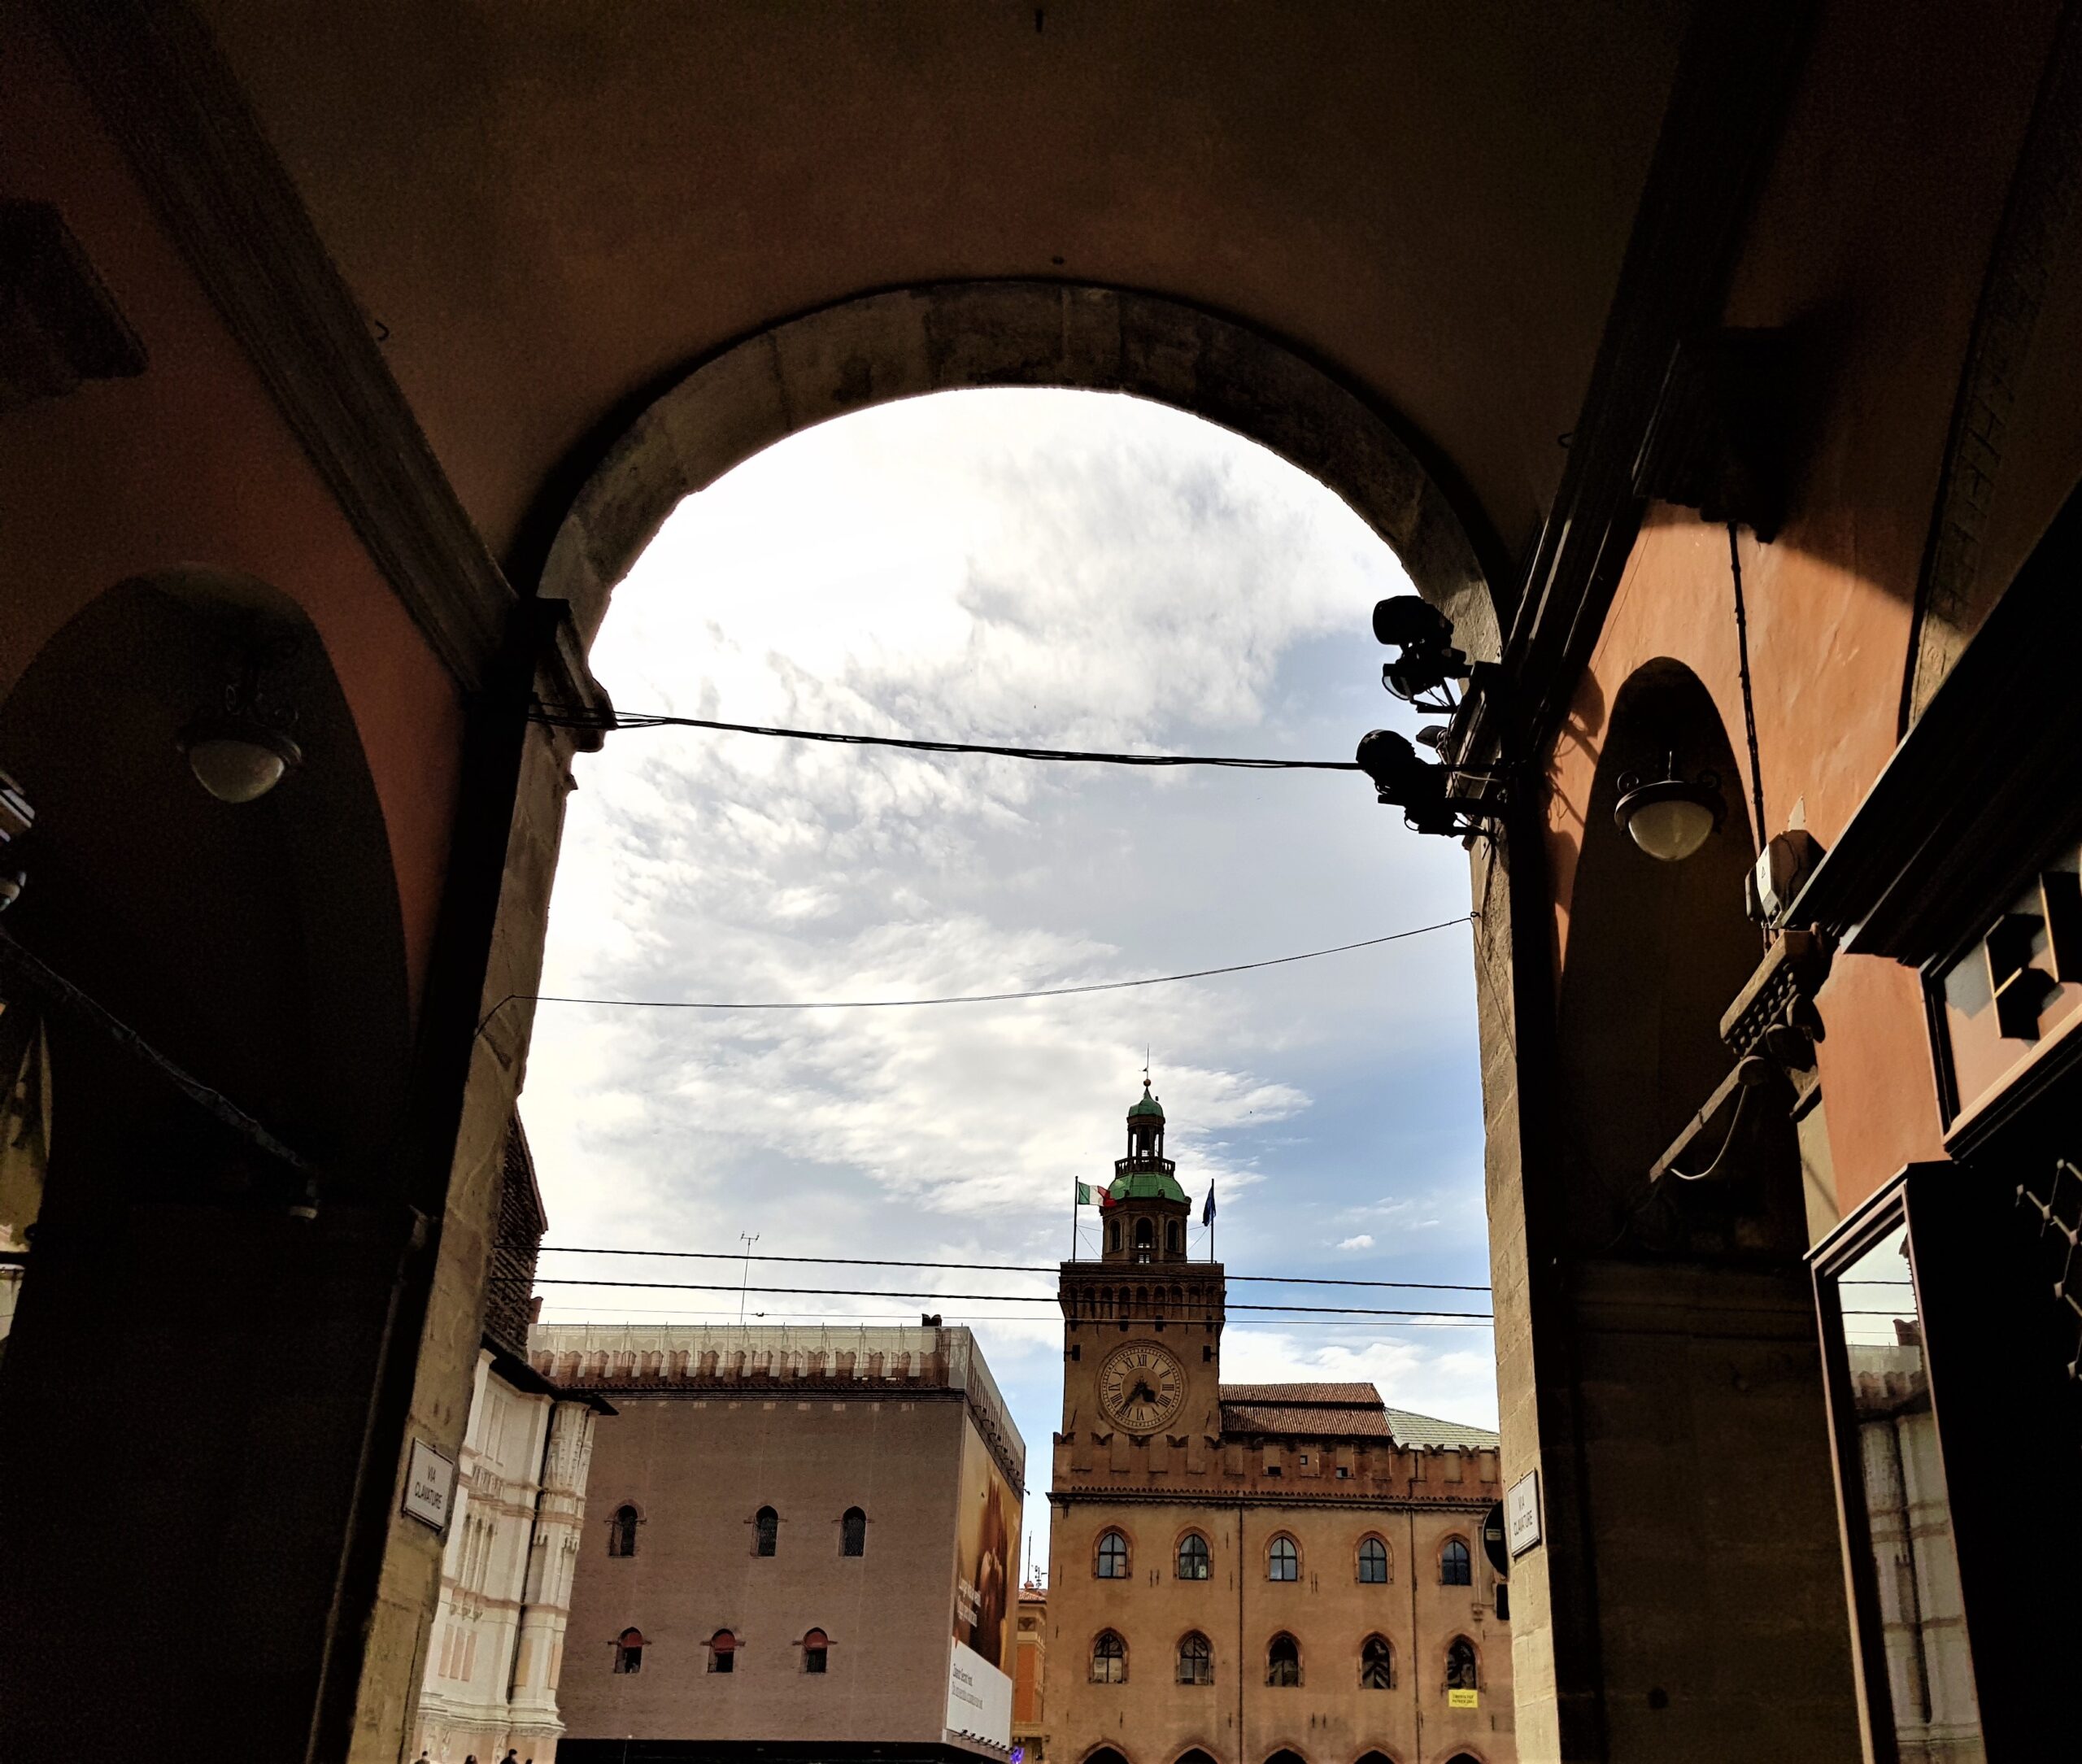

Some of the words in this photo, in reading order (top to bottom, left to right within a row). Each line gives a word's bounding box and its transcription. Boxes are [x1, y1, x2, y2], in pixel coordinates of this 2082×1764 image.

[1123, 1357, 1135, 1370] XI
[1137, 1354, 1147, 1366] XII
[1152, 1358, 1158, 1370] I
[1112, 1369, 1125, 1379] X
[1159, 1370, 1171, 1379] II
[1109, 1383, 1121, 1391] IX
[1110, 1392, 1123, 1408] VIII
[1156, 1394, 1172, 1408] IIII
[1136, 1408, 1144, 1421] VI
[1152, 1407, 1159, 1418] V
[428, 1465, 436, 1483] VIA
[415, 1482, 442, 1509] CLAVATURE
